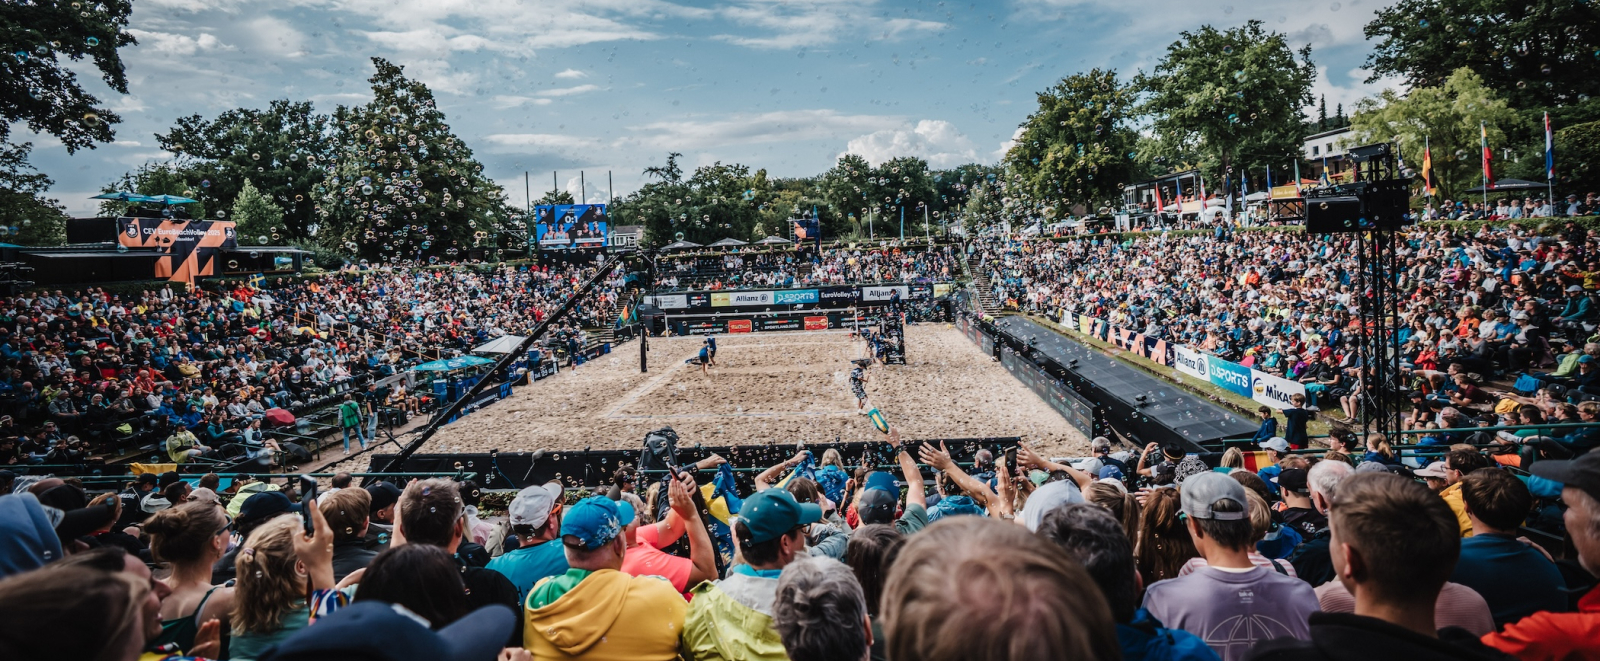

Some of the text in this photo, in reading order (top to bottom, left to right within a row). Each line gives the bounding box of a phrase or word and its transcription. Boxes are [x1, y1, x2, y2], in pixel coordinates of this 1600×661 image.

[565, 215, 578, 223] 0:1
[143, 227, 157, 235] CEV
[820, 290, 861, 299] EuroVolley.TV
[1176, 351, 1196, 370] Allianz
[1210, 365, 1249, 388] D.SPORTS
